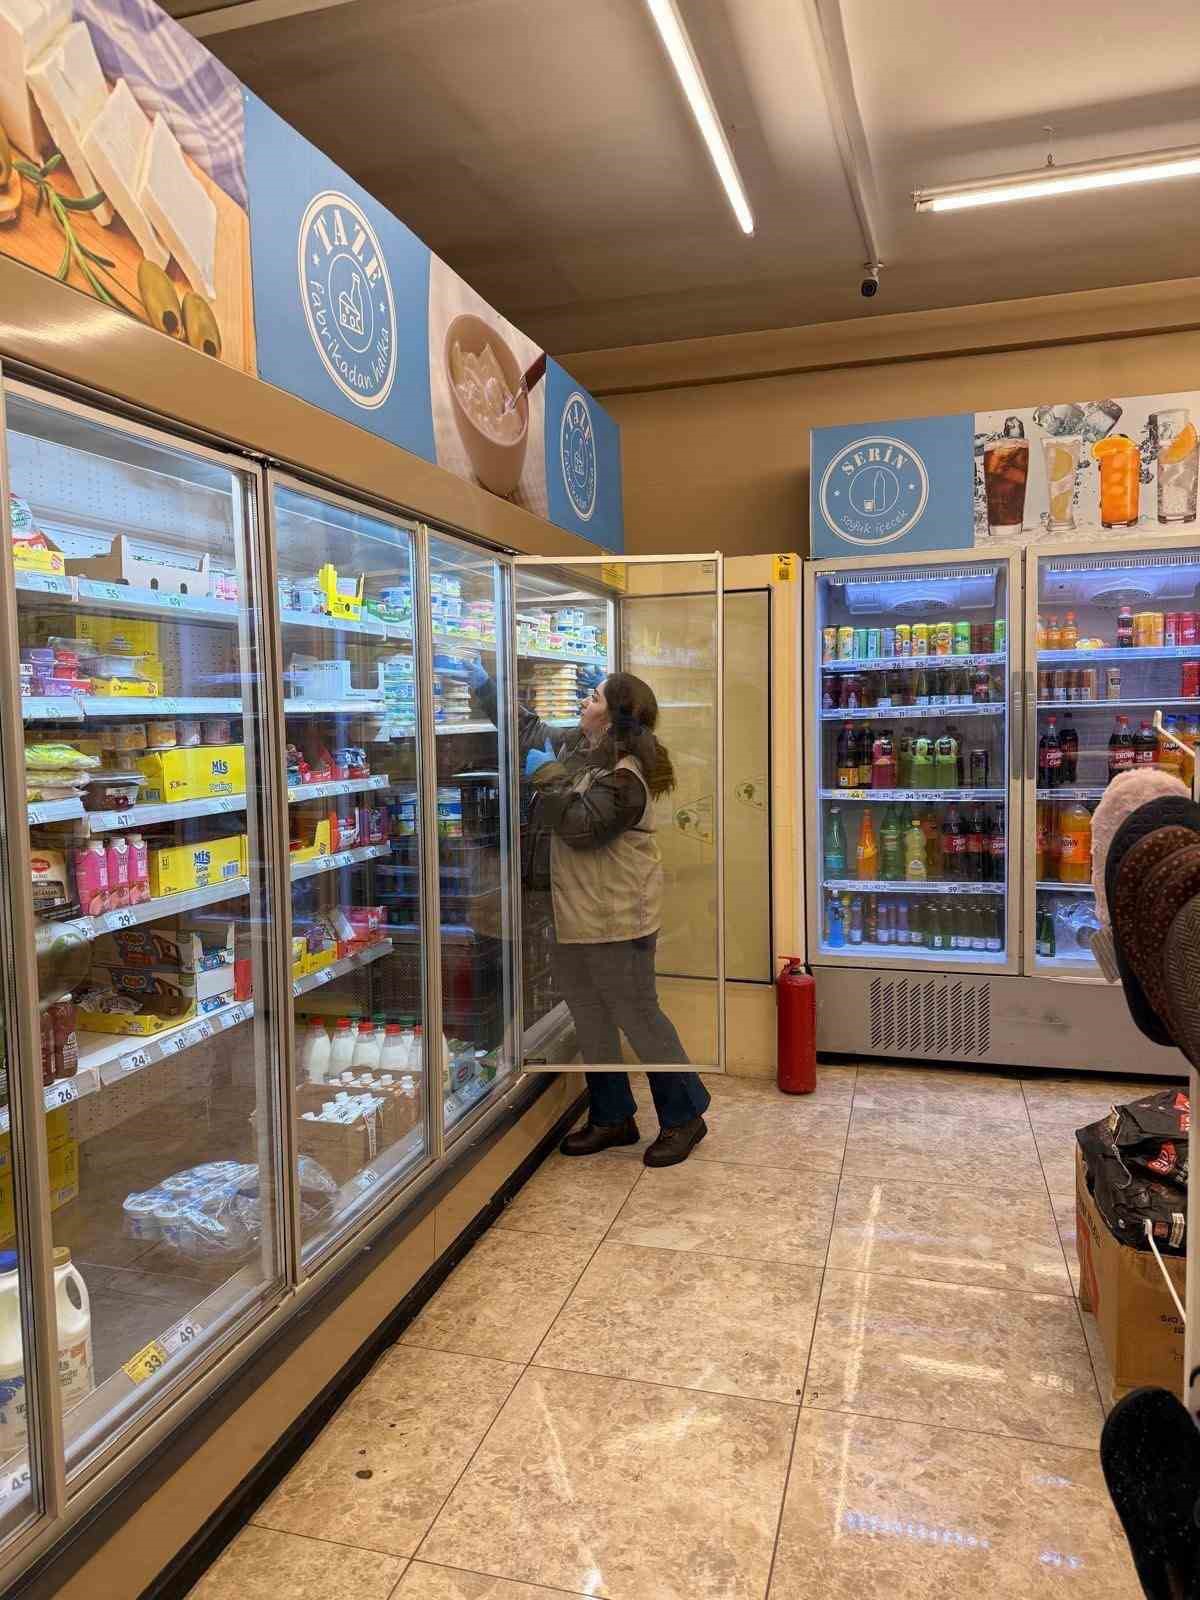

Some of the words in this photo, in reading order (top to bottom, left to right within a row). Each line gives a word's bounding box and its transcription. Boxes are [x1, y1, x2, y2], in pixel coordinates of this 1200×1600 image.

[313, 207, 383, 289] TAZE
[840, 446, 908, 477] SERİN
[118, 914, 131, 927] 29
[174, 1038, 186, 1051] 18
[131, 1055, 146, 1068] 24
[57, 1089, 73, 1104] 26
[179, 1326, 195, 1345] 49
[144, 1354, 163, 1375] 33
